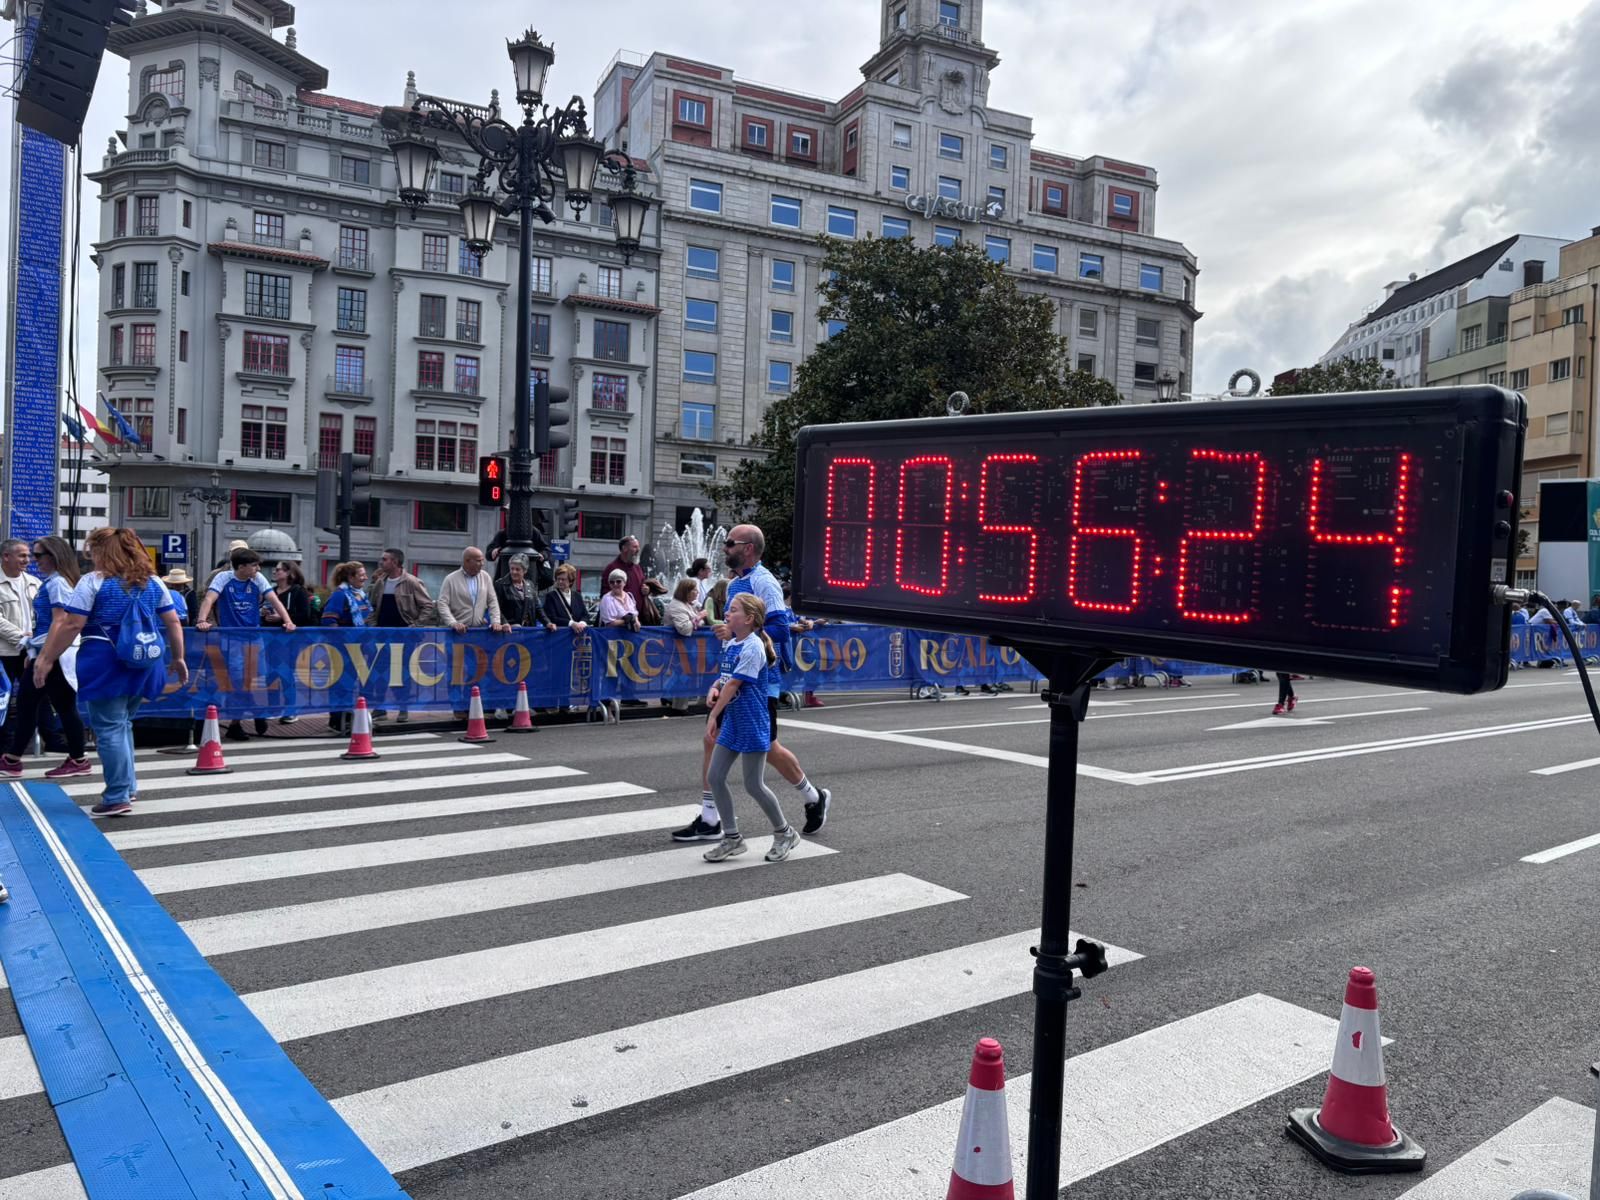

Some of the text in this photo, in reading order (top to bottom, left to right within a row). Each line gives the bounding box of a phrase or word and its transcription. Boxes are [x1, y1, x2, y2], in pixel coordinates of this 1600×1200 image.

[168, 535, 182, 552] P
[824, 450, 1411, 628] 00:56:24
[294, 642, 532, 690] OVIEDO
[606, 637, 866, 684] REAL EDO
[920, 636, 995, 675] REAL
